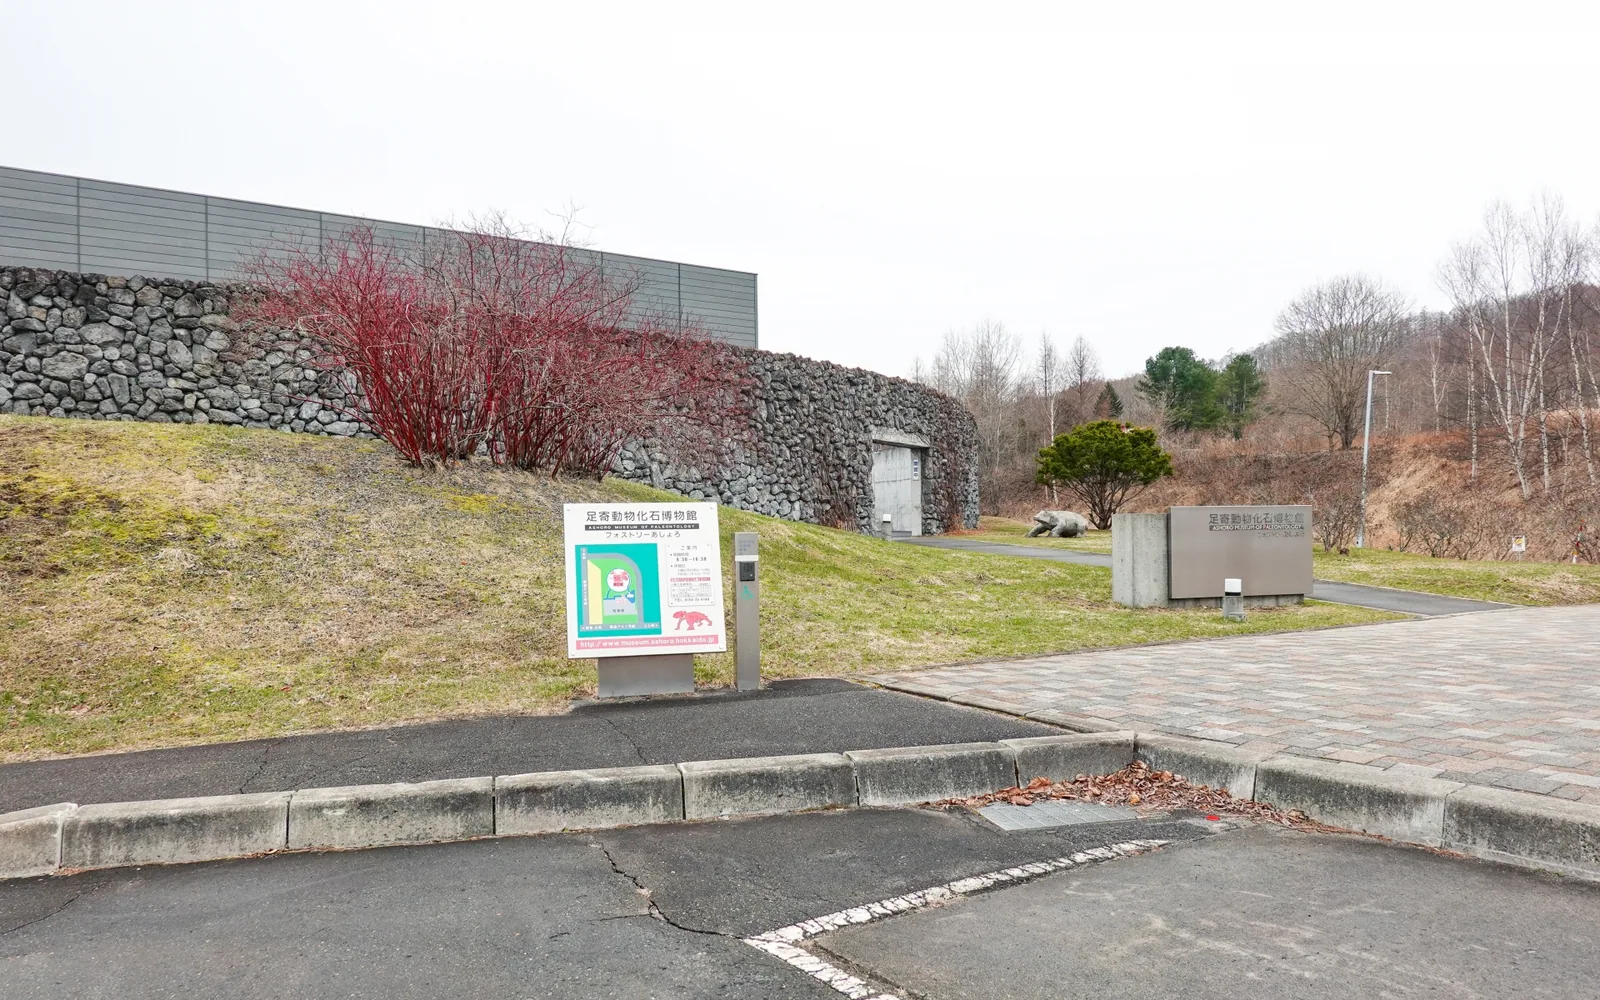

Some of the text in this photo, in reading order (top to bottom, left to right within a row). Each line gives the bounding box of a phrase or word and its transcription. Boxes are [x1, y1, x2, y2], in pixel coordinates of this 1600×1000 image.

[586, 510, 698, 522] 足寄動物化石博物館
[1209, 512, 1304, 524] 足寄動物化石博物館
